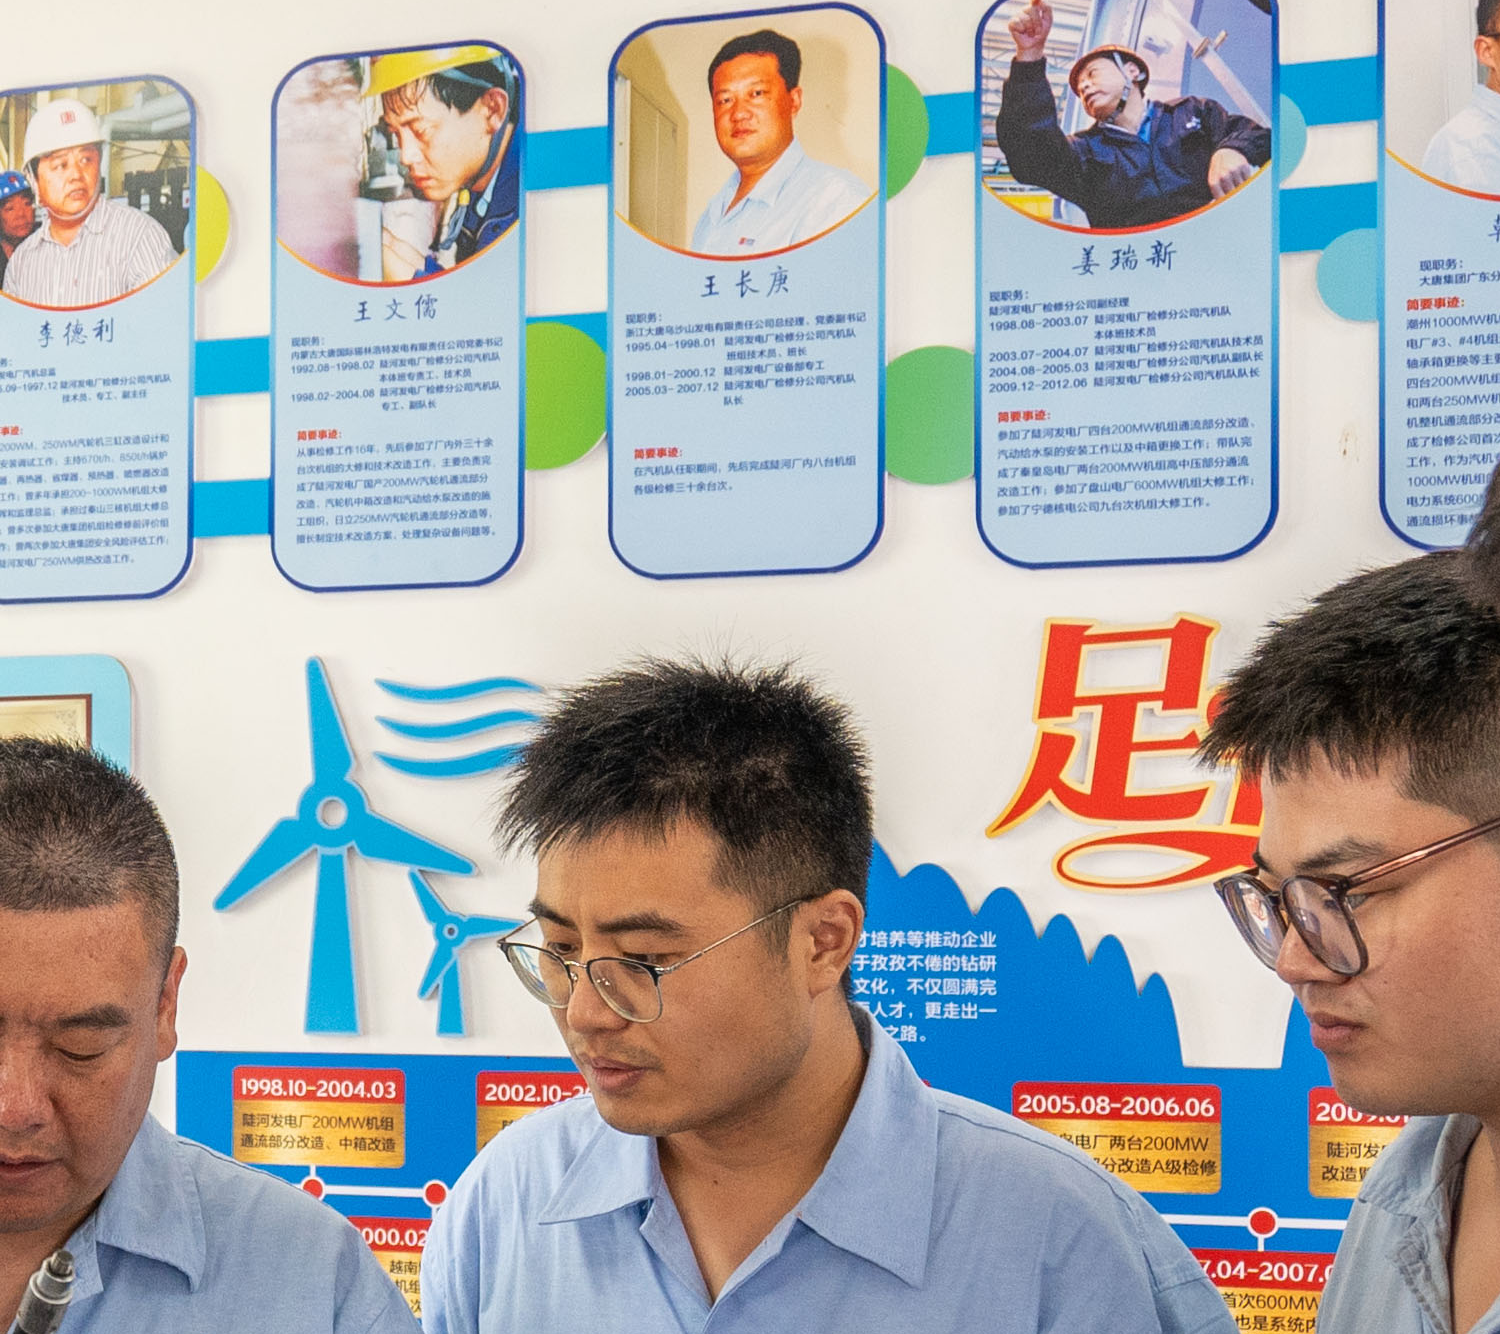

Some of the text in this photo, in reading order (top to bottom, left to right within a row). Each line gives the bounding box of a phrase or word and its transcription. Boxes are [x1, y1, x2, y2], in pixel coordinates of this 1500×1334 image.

[1071, 239, 1178, 276] 姜瑞新
[989, 315, 1089, 332] 1998.08-2003.07
[38, 317, 114, 348] 李德利
[625, 338, 716, 353] 1995.04-1998.01
[988, 347, 1089, 363] 2003.07-2004.07
[625, 368, 716, 382] 1998.01-2000.12
[988, 362, 1089, 378] 2004.08-2005.03
[988, 377, 1088, 394] 2009.12-2012.06
[723, 395, 744, 407] 队长
[985, 611, 1264, 896] 足
[852, 954, 997, 972] 于孜孜不倦的钻研
[853, 977, 997, 996] 文化，不仅圆满完
[240, 1078, 397, 1099] 1998.10-2004.03
[1018, 1094, 1215, 1117] 2005.08-2006.06
[242, 1113, 395, 1132] 陡河发电厂200MW机组
[240, 1133, 396, 1153] 通流部分改造、中箱改造
[1327, 1142, 1388, 1159] 陡河发
[389, 1260, 422, 1276] 越南
